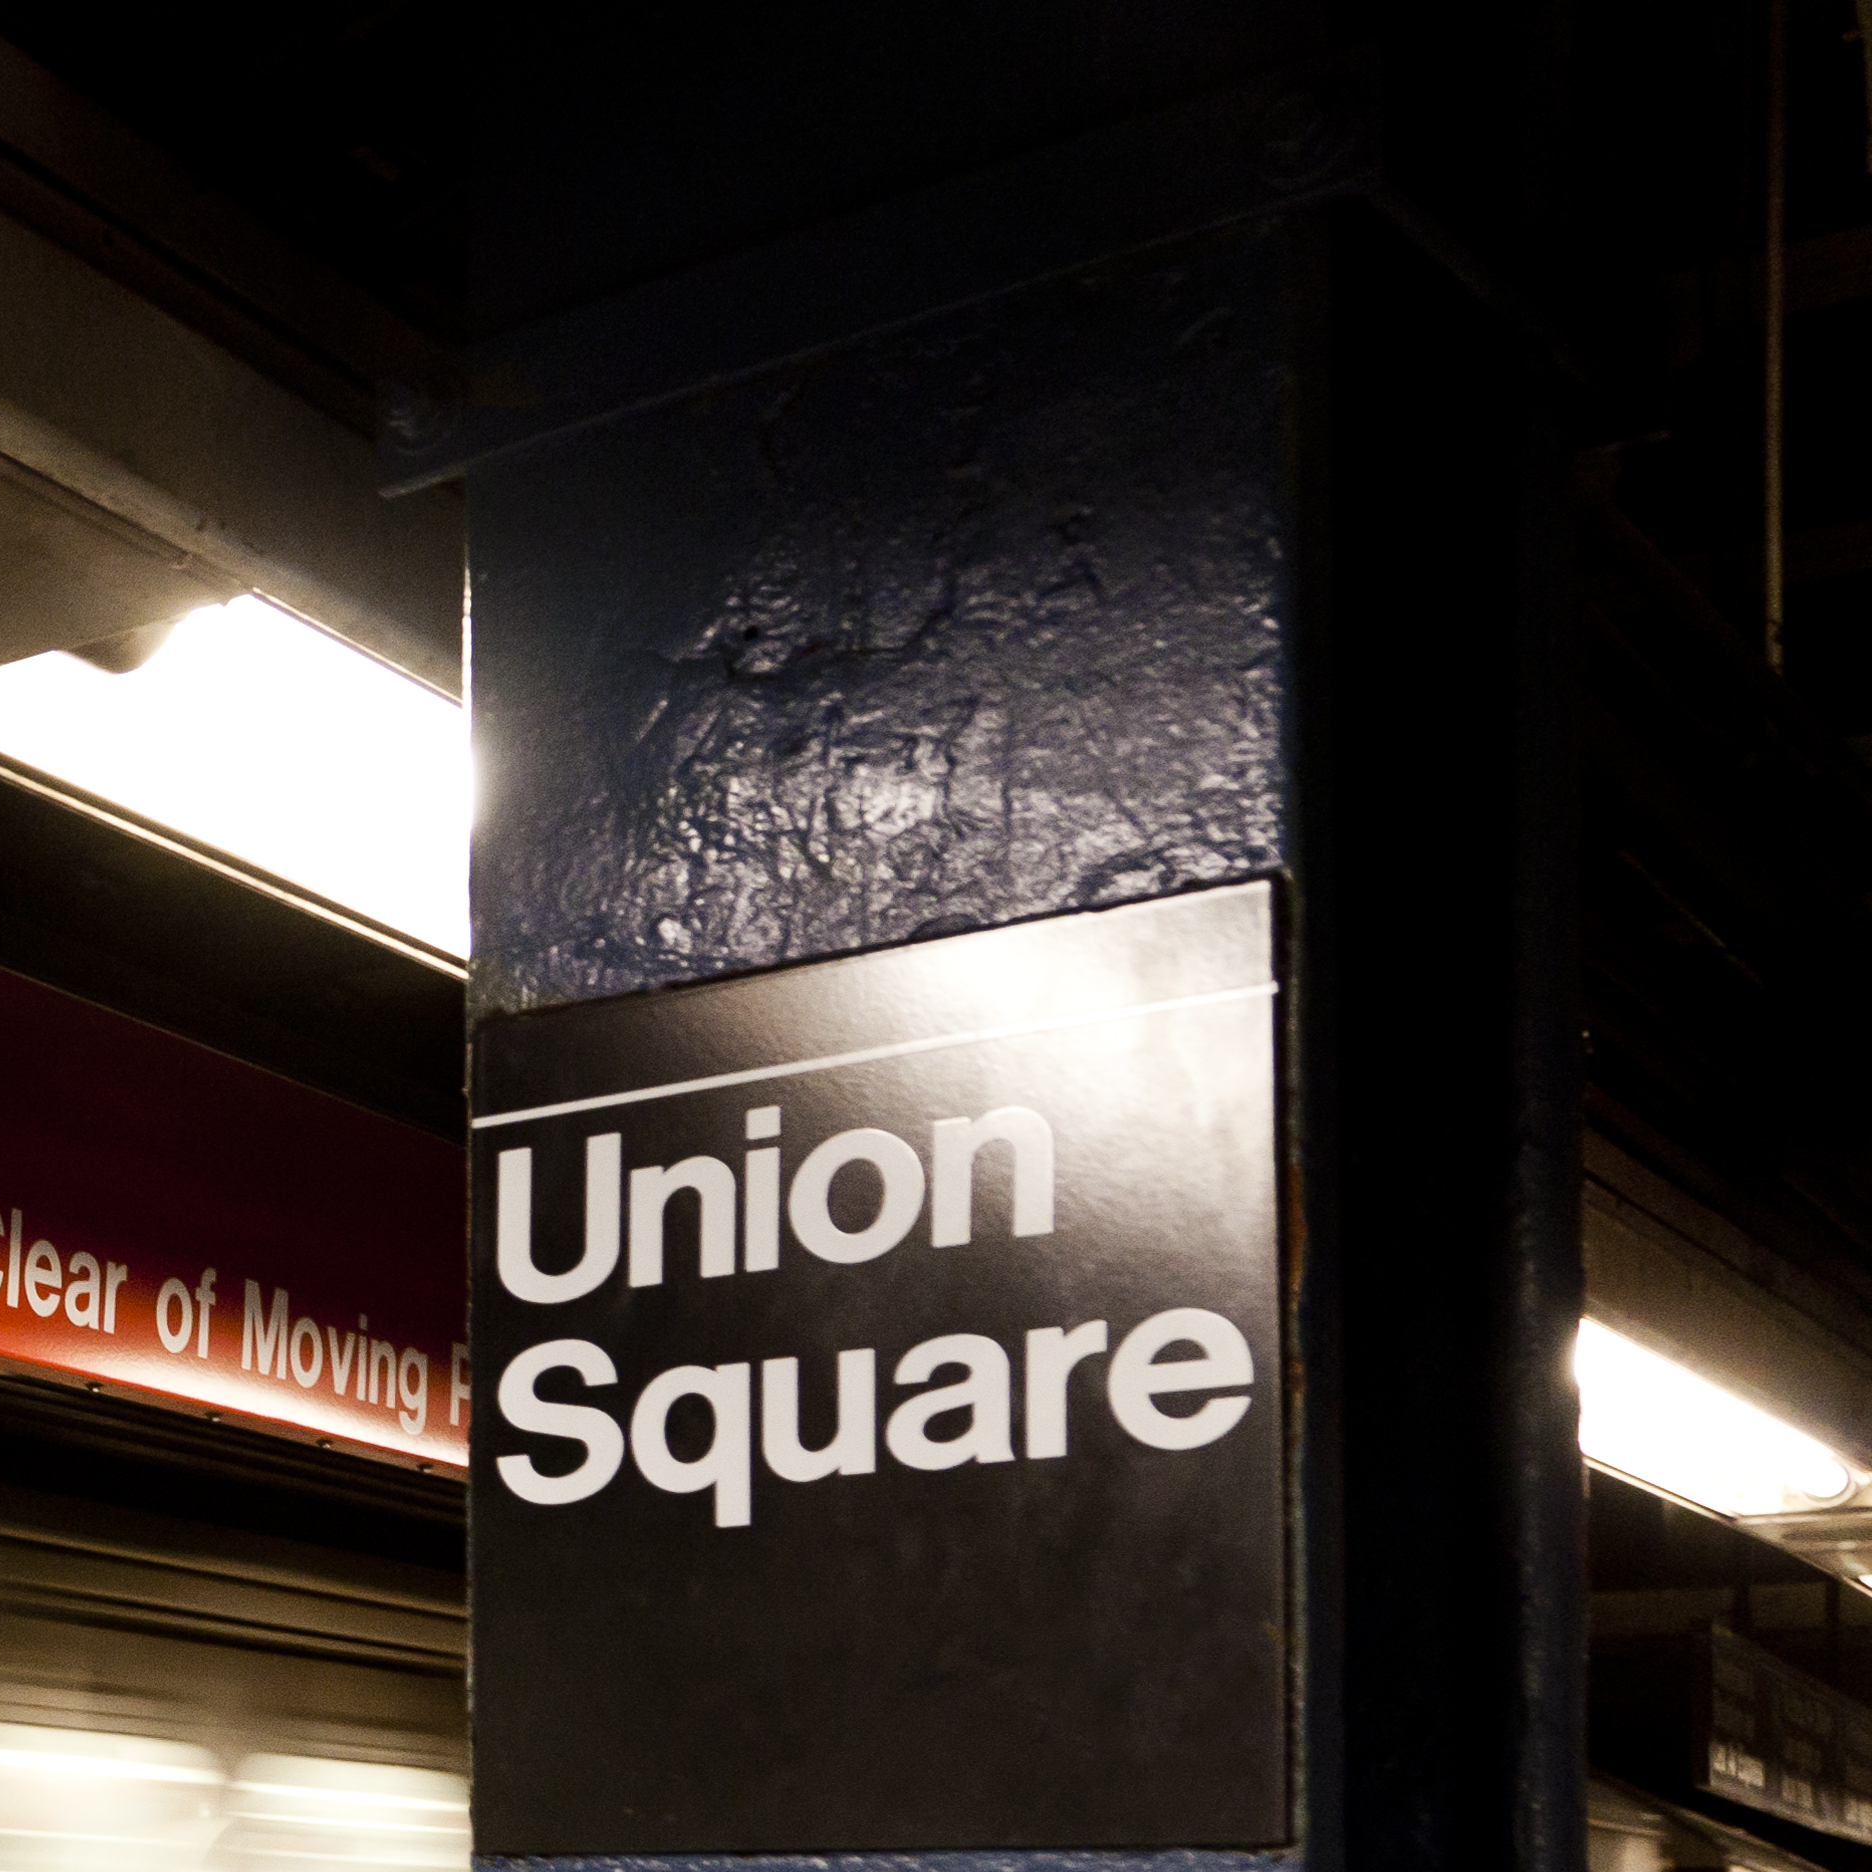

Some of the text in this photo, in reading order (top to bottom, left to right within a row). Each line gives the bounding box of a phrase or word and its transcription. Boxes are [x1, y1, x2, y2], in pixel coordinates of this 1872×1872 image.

[496, 1105, 1055, 1304] Union
[156, 1267, 217, 1359] of
[241, 1279, 428, 1436] Moving
[496, 1307, 1254, 1528] Square
